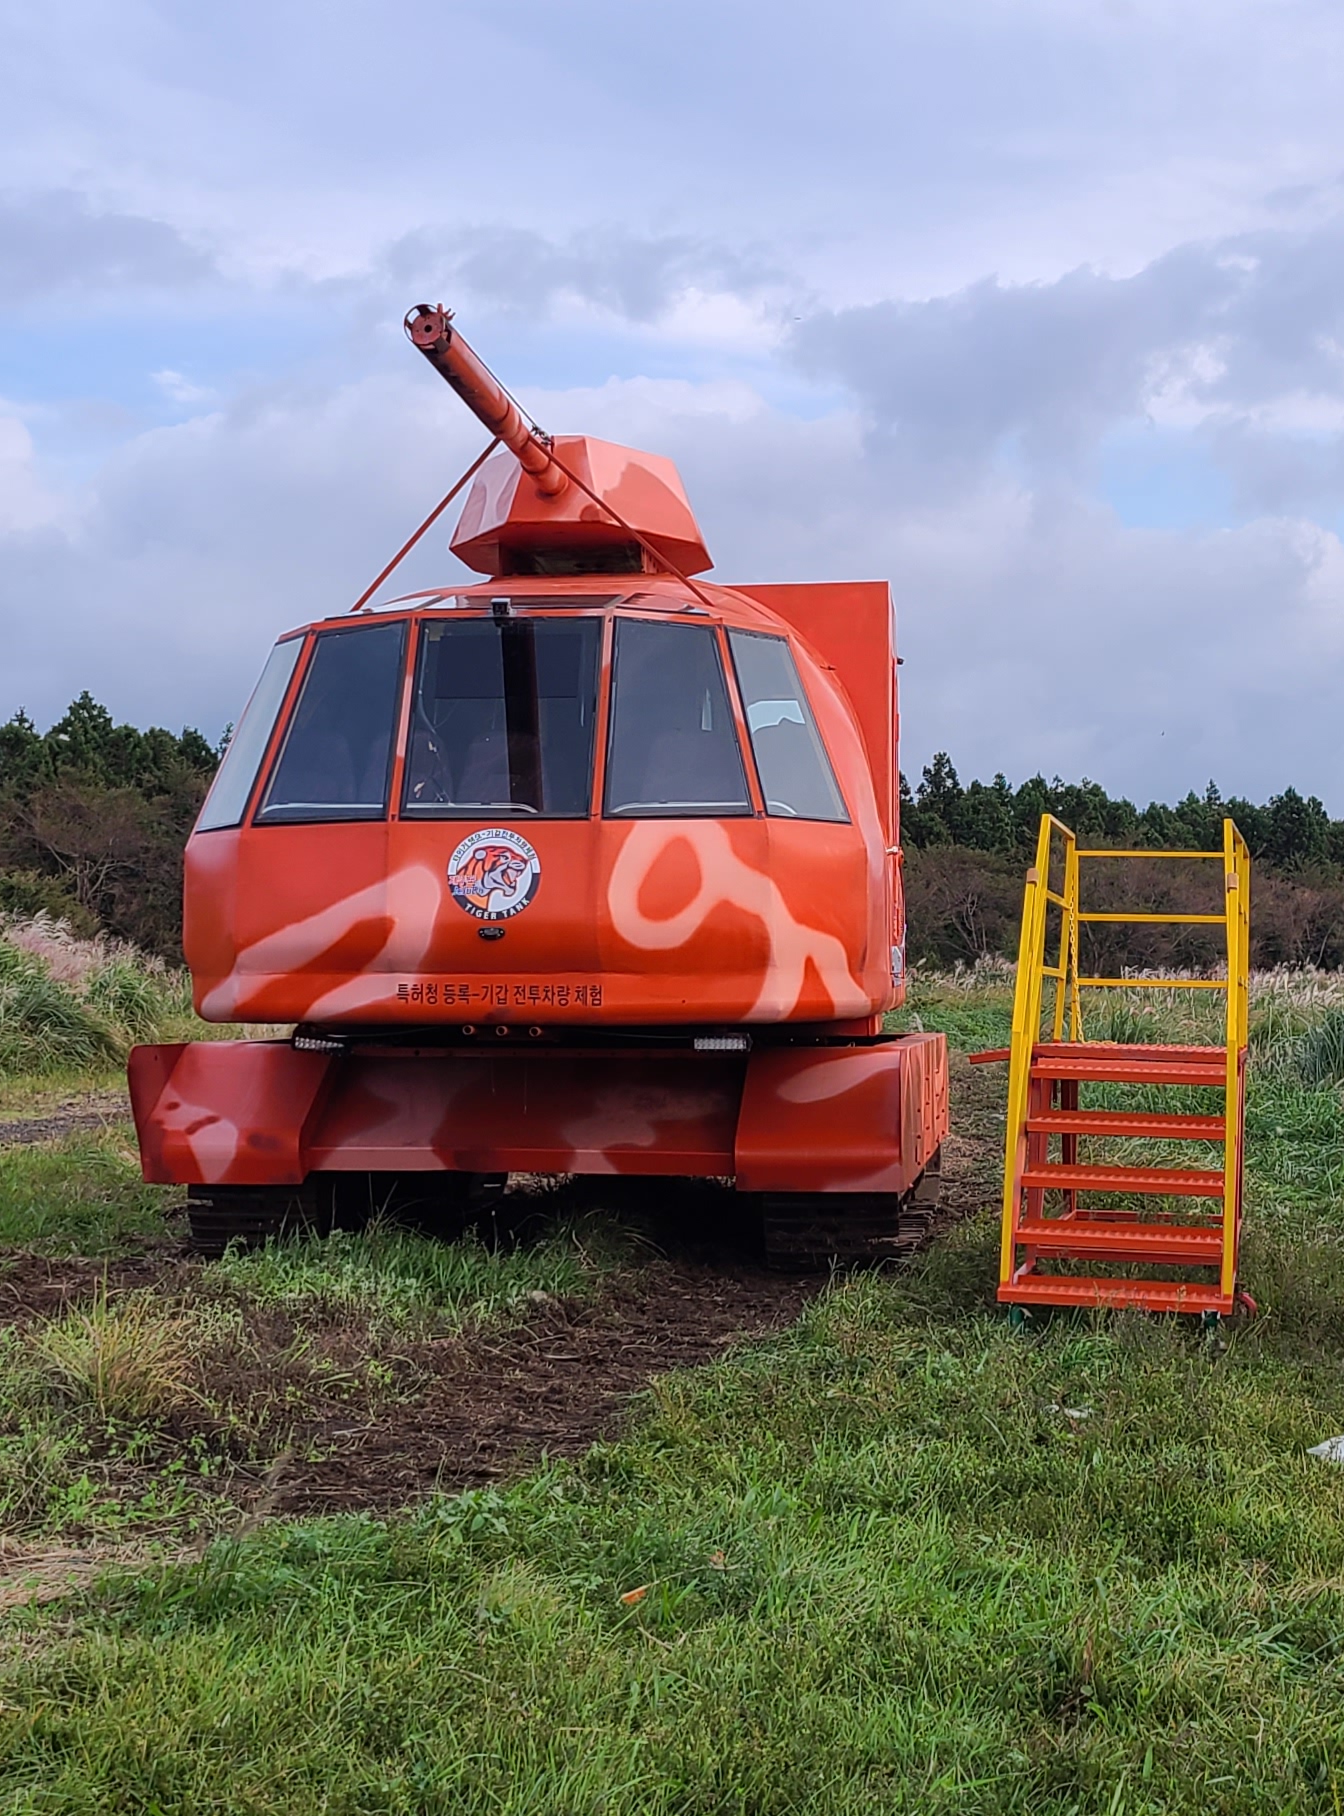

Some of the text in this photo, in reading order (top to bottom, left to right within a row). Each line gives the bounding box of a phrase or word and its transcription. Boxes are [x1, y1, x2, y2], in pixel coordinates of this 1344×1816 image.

[464, 897, 530, 920] TIGER TANK
[396, 983, 603, 1007] 특허청 등록-기갑 전투차량 체험
